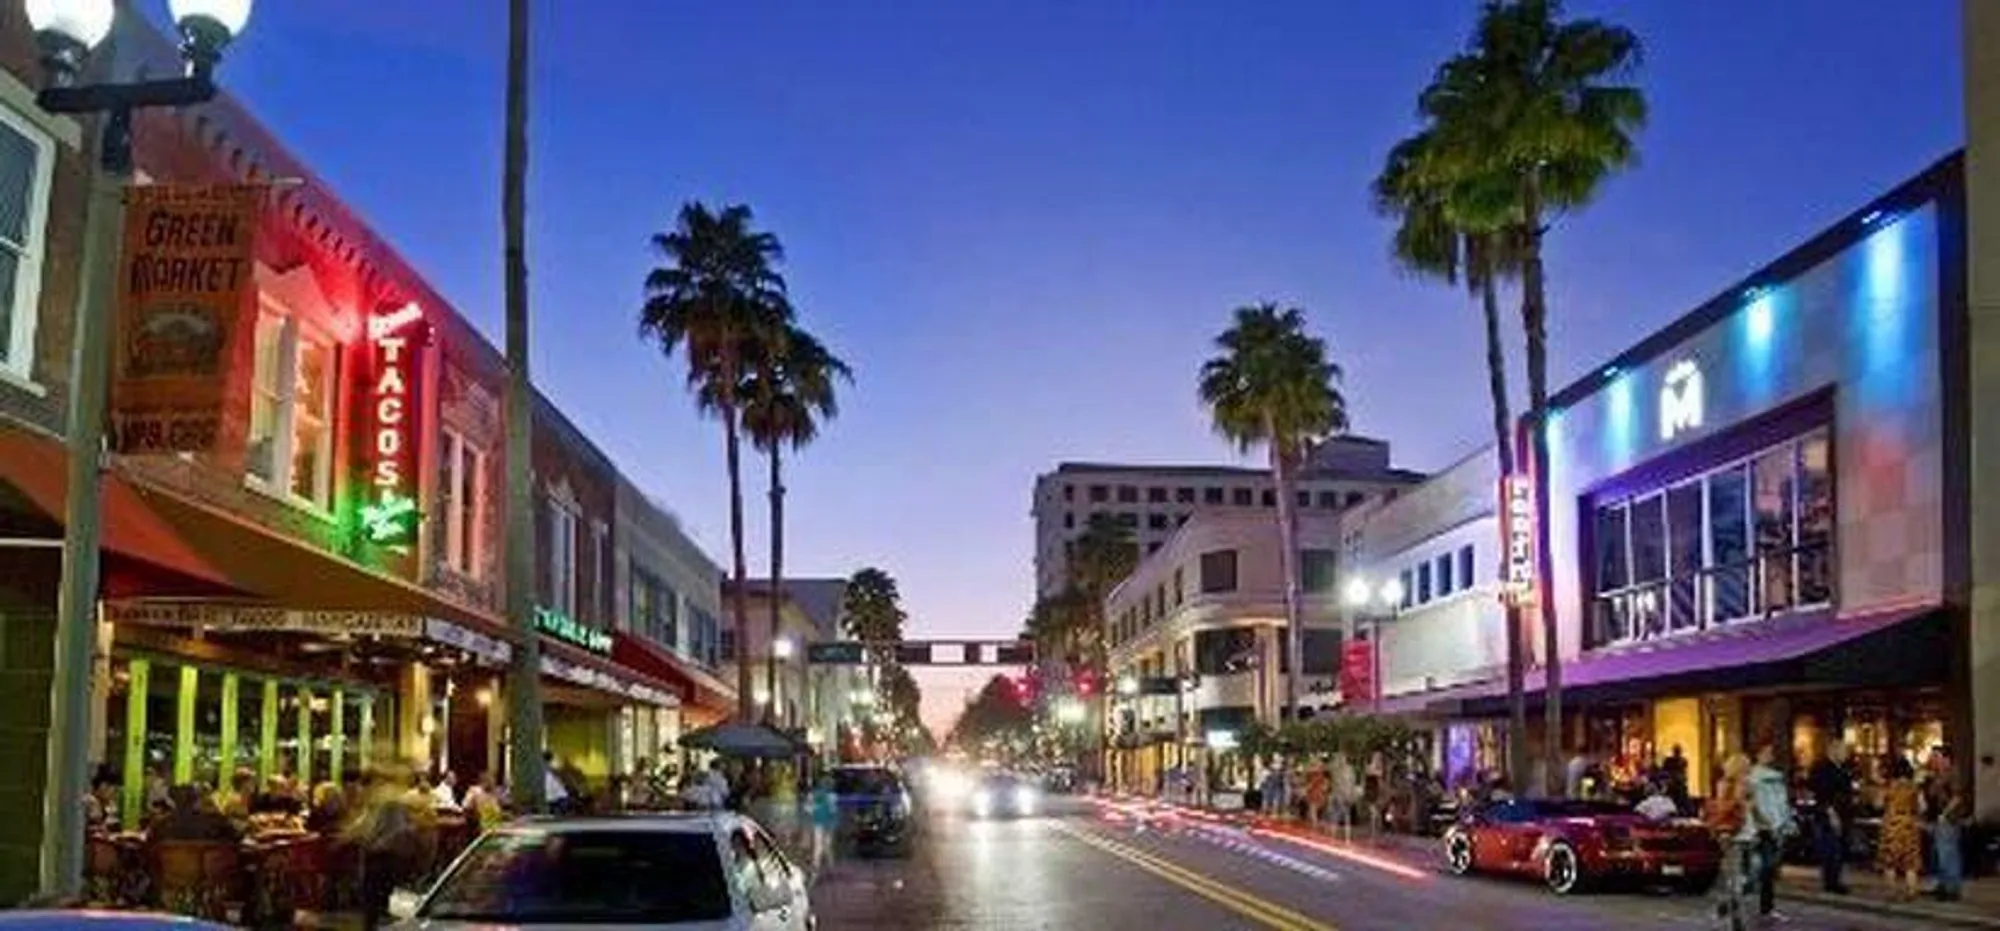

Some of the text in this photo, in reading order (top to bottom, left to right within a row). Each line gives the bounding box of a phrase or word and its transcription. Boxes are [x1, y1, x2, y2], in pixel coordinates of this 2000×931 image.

[146, 208, 237, 247] GREEN
[129, 253, 243, 293] MARKET
[375, 338, 406, 486] TACOS
[1661, 372, 1704, 440] M
